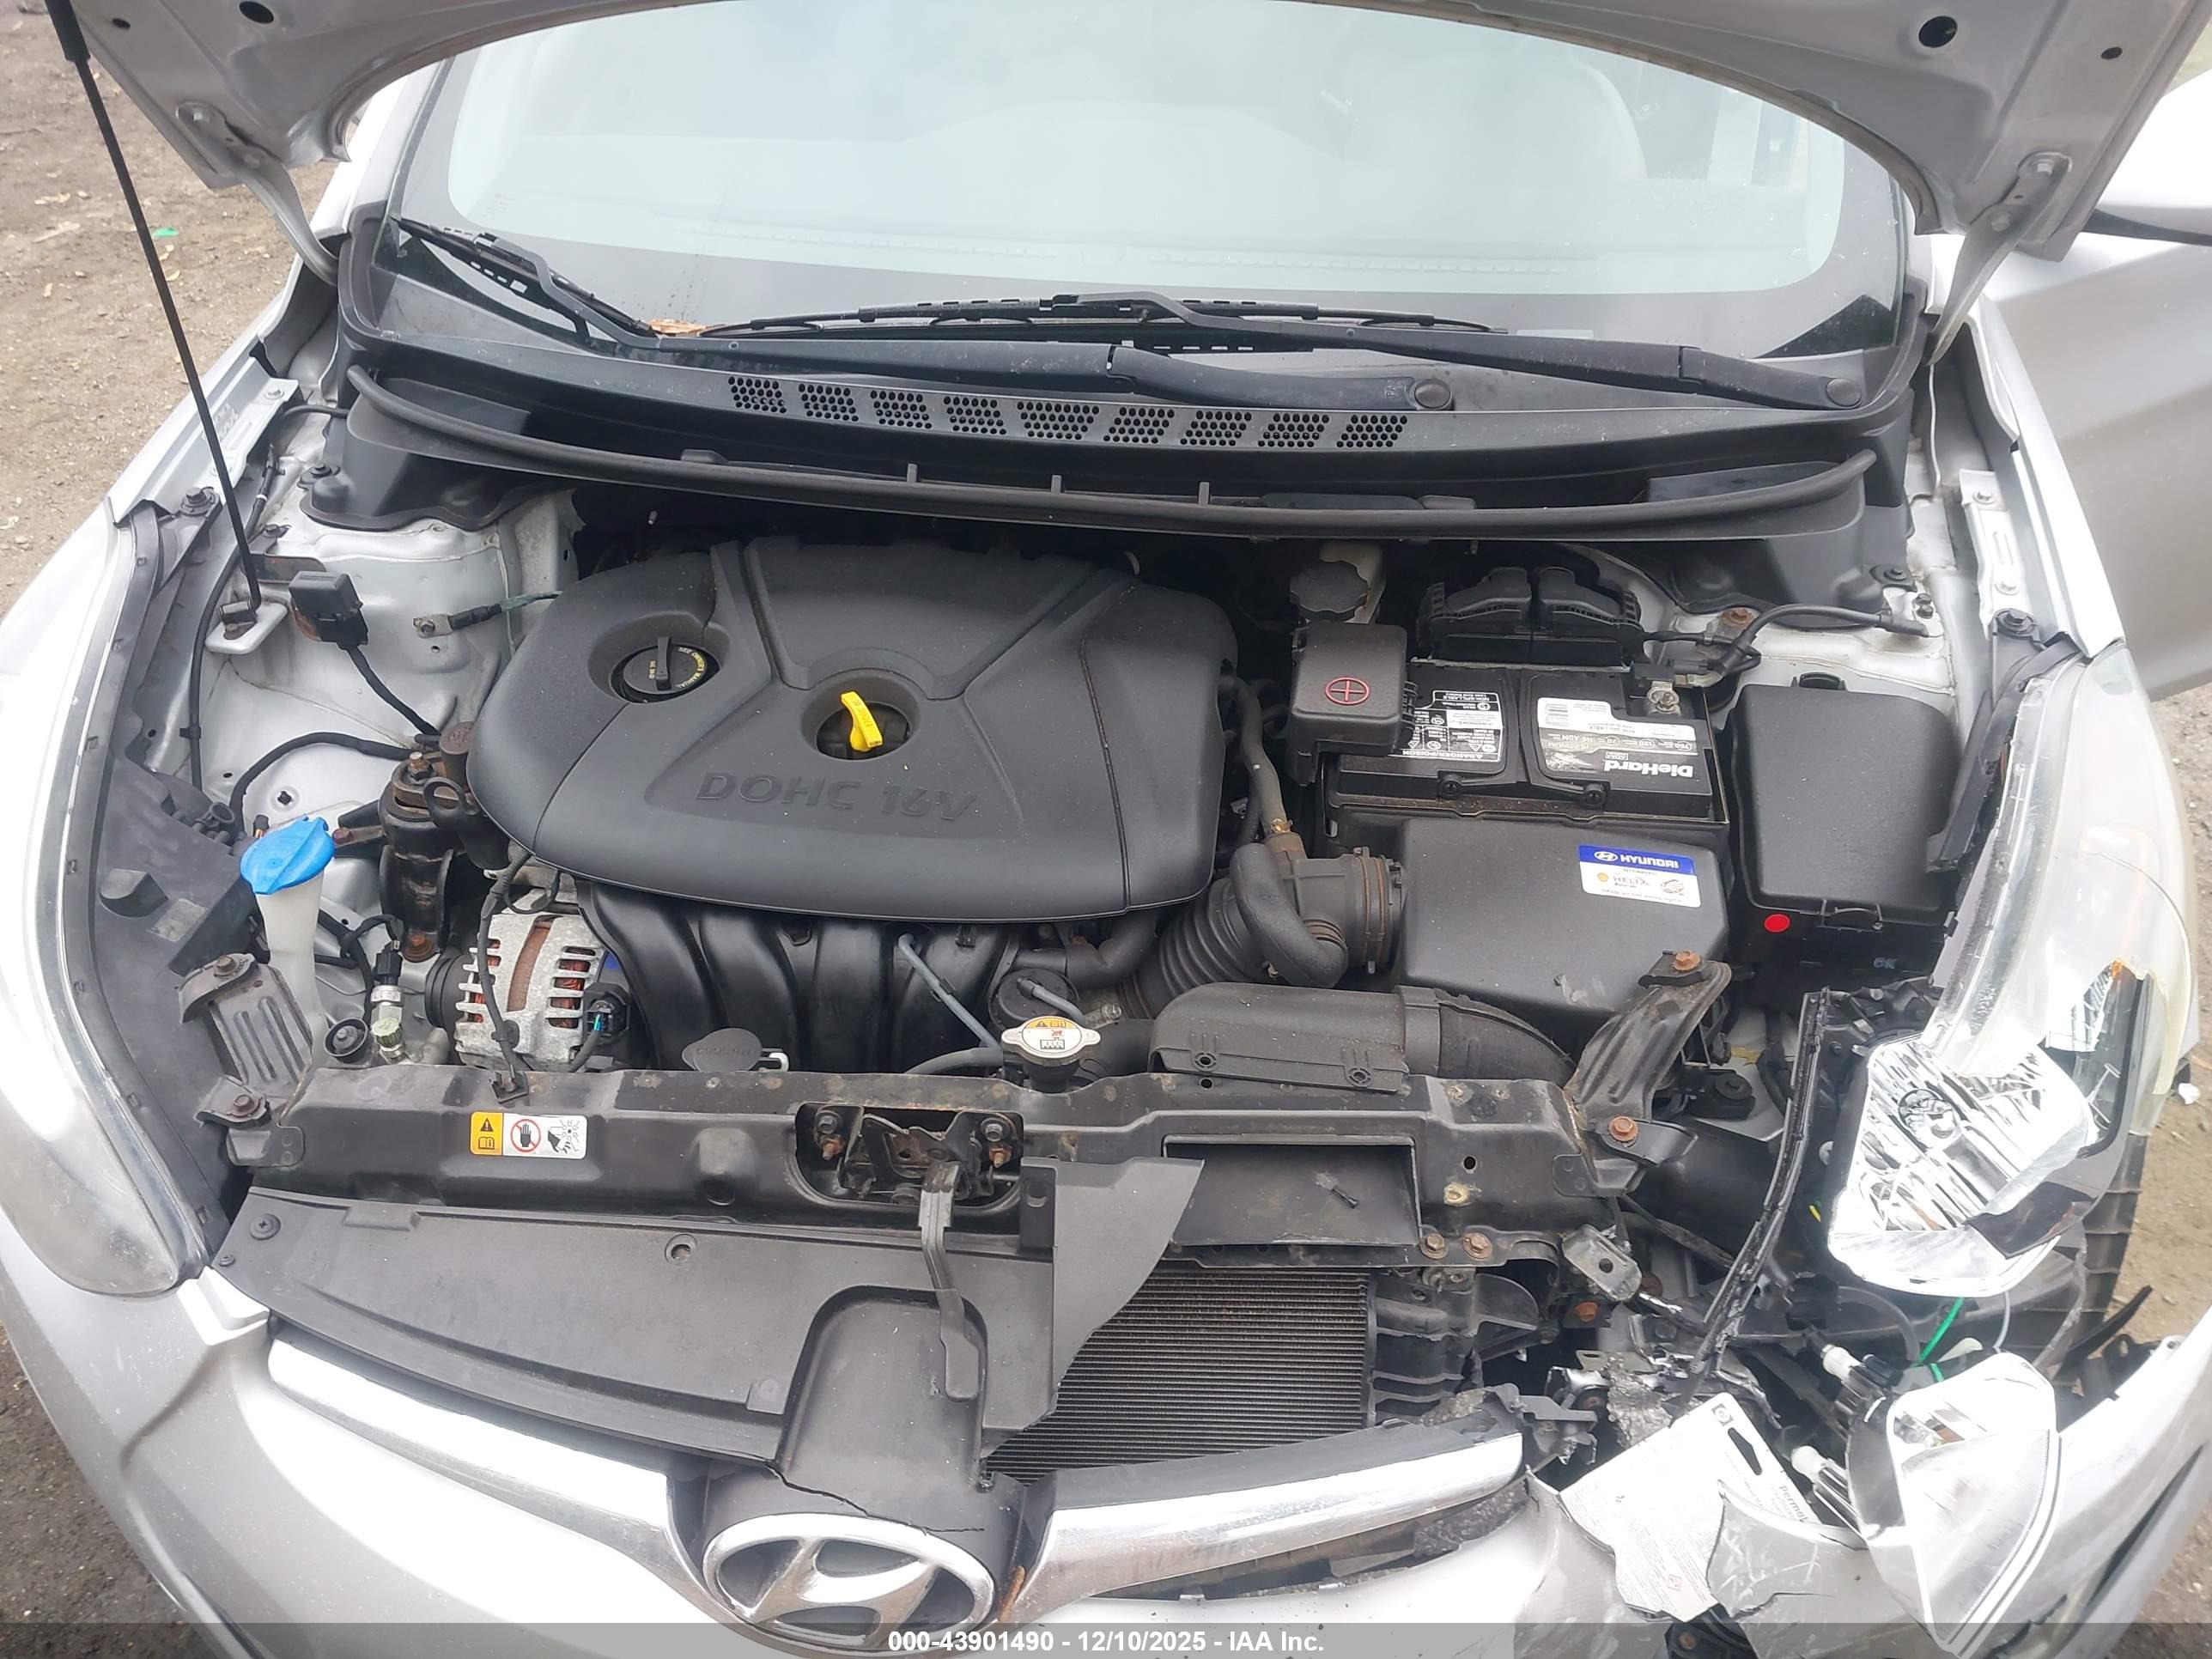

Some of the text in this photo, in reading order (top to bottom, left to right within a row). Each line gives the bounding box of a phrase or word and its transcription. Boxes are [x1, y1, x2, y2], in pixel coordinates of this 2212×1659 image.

[1603, 759, 1694, 778] DieHard
[694, 771, 978, 822] DOHC 16V
[1620, 854, 1680, 869] HYUNDAI
